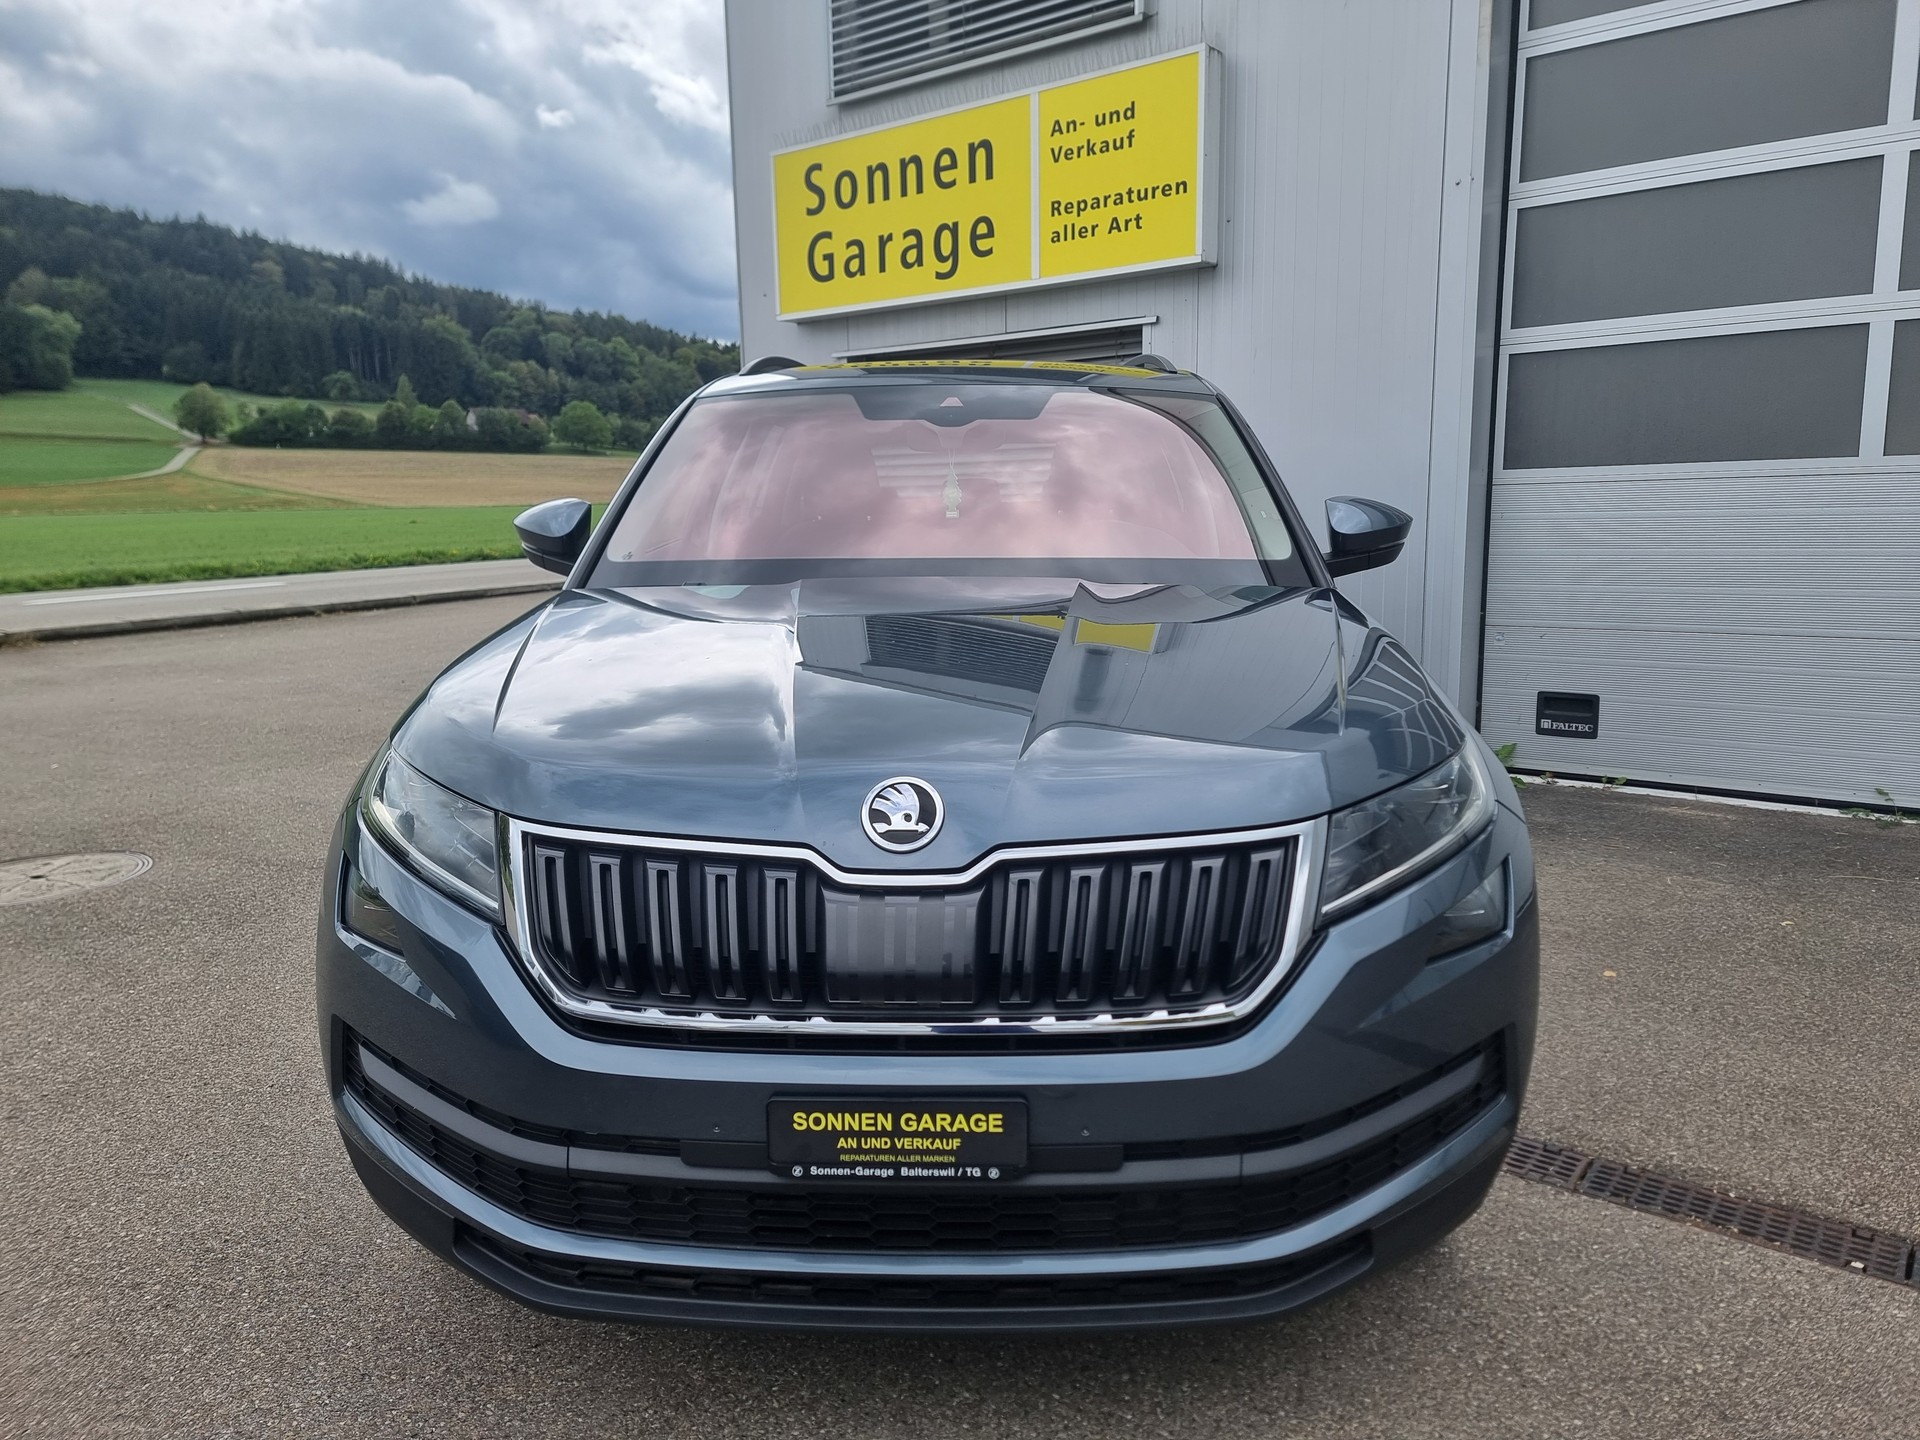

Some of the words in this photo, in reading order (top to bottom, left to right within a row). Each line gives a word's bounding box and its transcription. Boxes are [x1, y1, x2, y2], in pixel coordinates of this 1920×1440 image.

[1050, 119, 1085, 137] An-
[1095, 101, 1136, 127] und
[1050, 129, 1135, 163] Verkauf
[804, 138, 994, 216] Sonnen
[1050, 179, 1188, 217] Reparaturen
[1050, 223, 1099, 243] aller
[1107, 213, 1143, 234] Art
[807, 215, 995, 283] Garage
[1552, 722, 1593, 732] FALTEC
[793, 1112, 892, 1131] SONNEN
[900, 1112, 1003, 1132] GARAGE
[837, 1137, 857, 1149] AN
[861, 1137, 891, 1149] UND
[894, 1137, 961, 1150] VERKAUF
[840, 1154, 895, 1162] REPARATUREN
[897, 1154, 920, 1162] ALLER
[810, 1166, 894, 1177] Sonnen-Garage
[901, 1167, 955, 1177] Balterswil
[965, 1167, 981, 1177] TG
